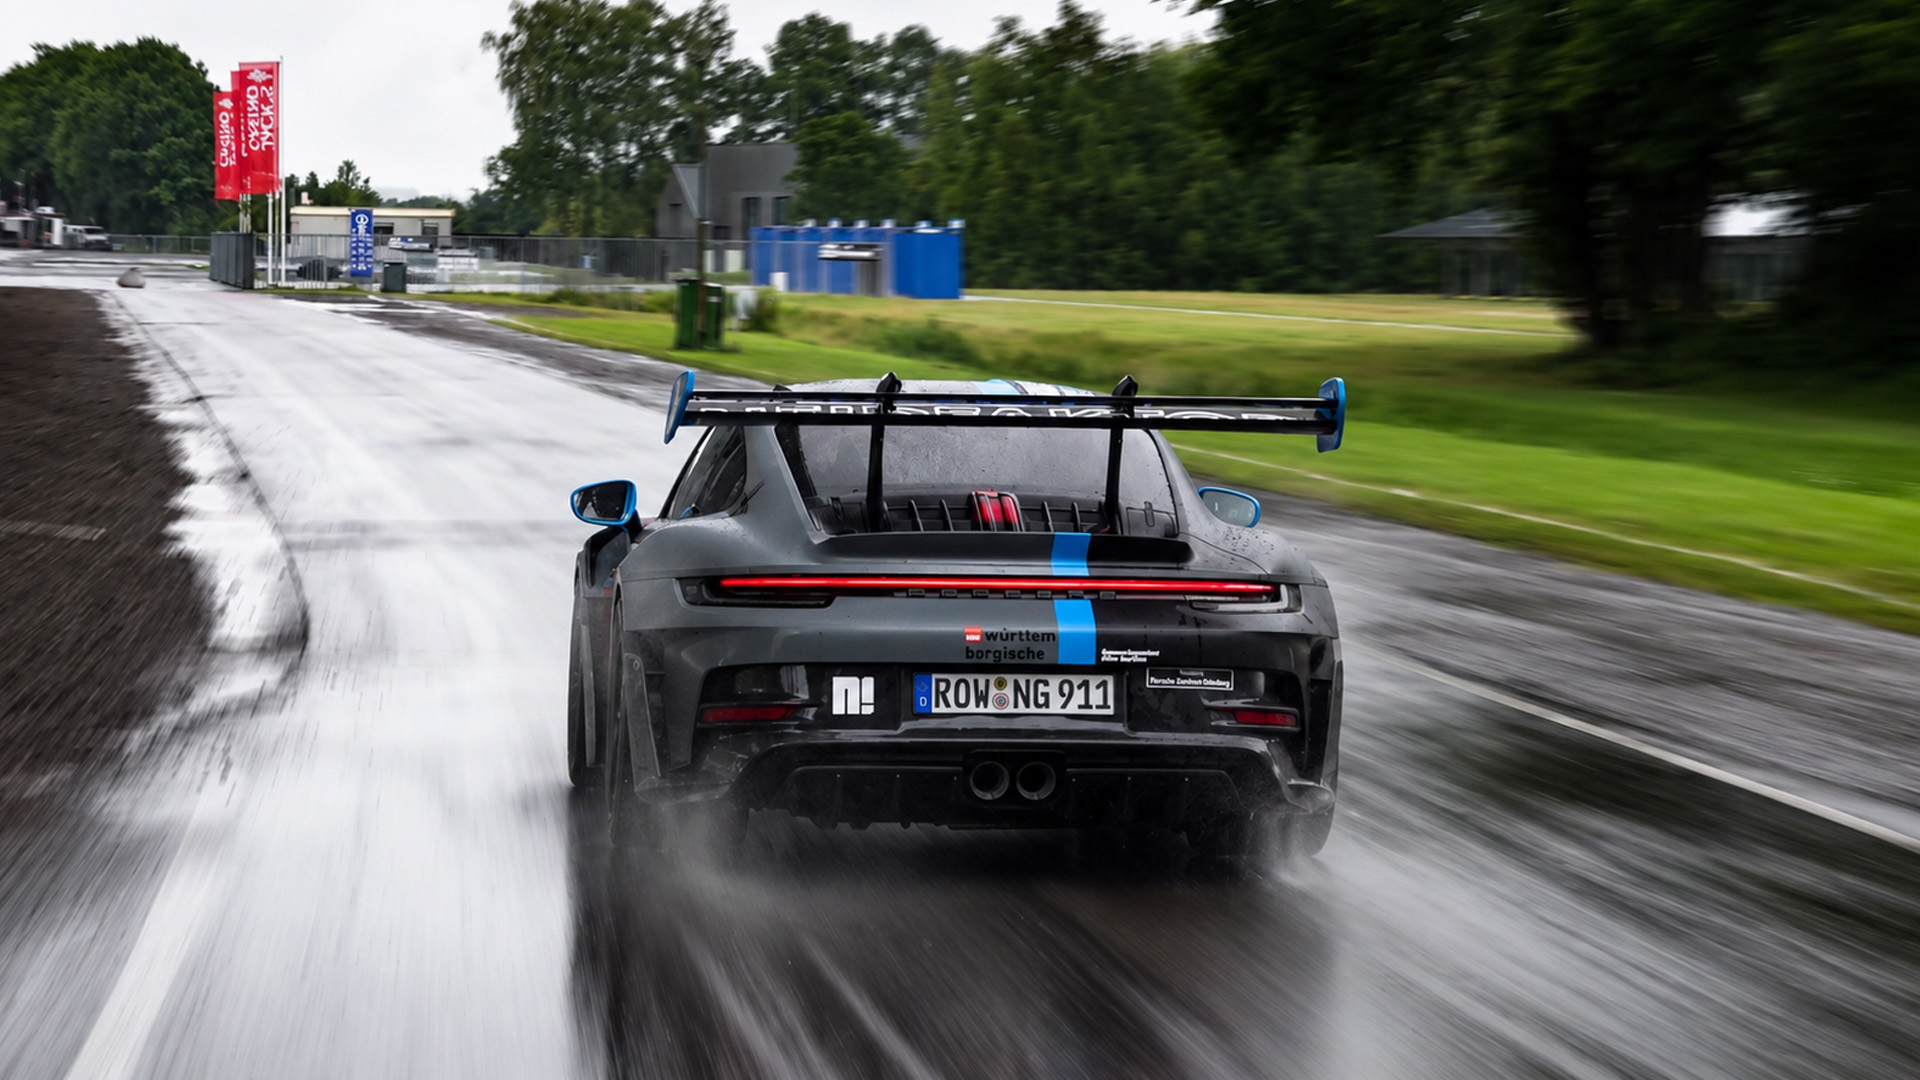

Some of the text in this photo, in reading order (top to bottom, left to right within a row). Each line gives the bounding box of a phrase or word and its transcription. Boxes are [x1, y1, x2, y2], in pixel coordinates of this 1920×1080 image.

[934, 677, 990, 709] ROW
[1013, 678, 1050, 709] NG
[1058, 679, 1112, 710] 911
